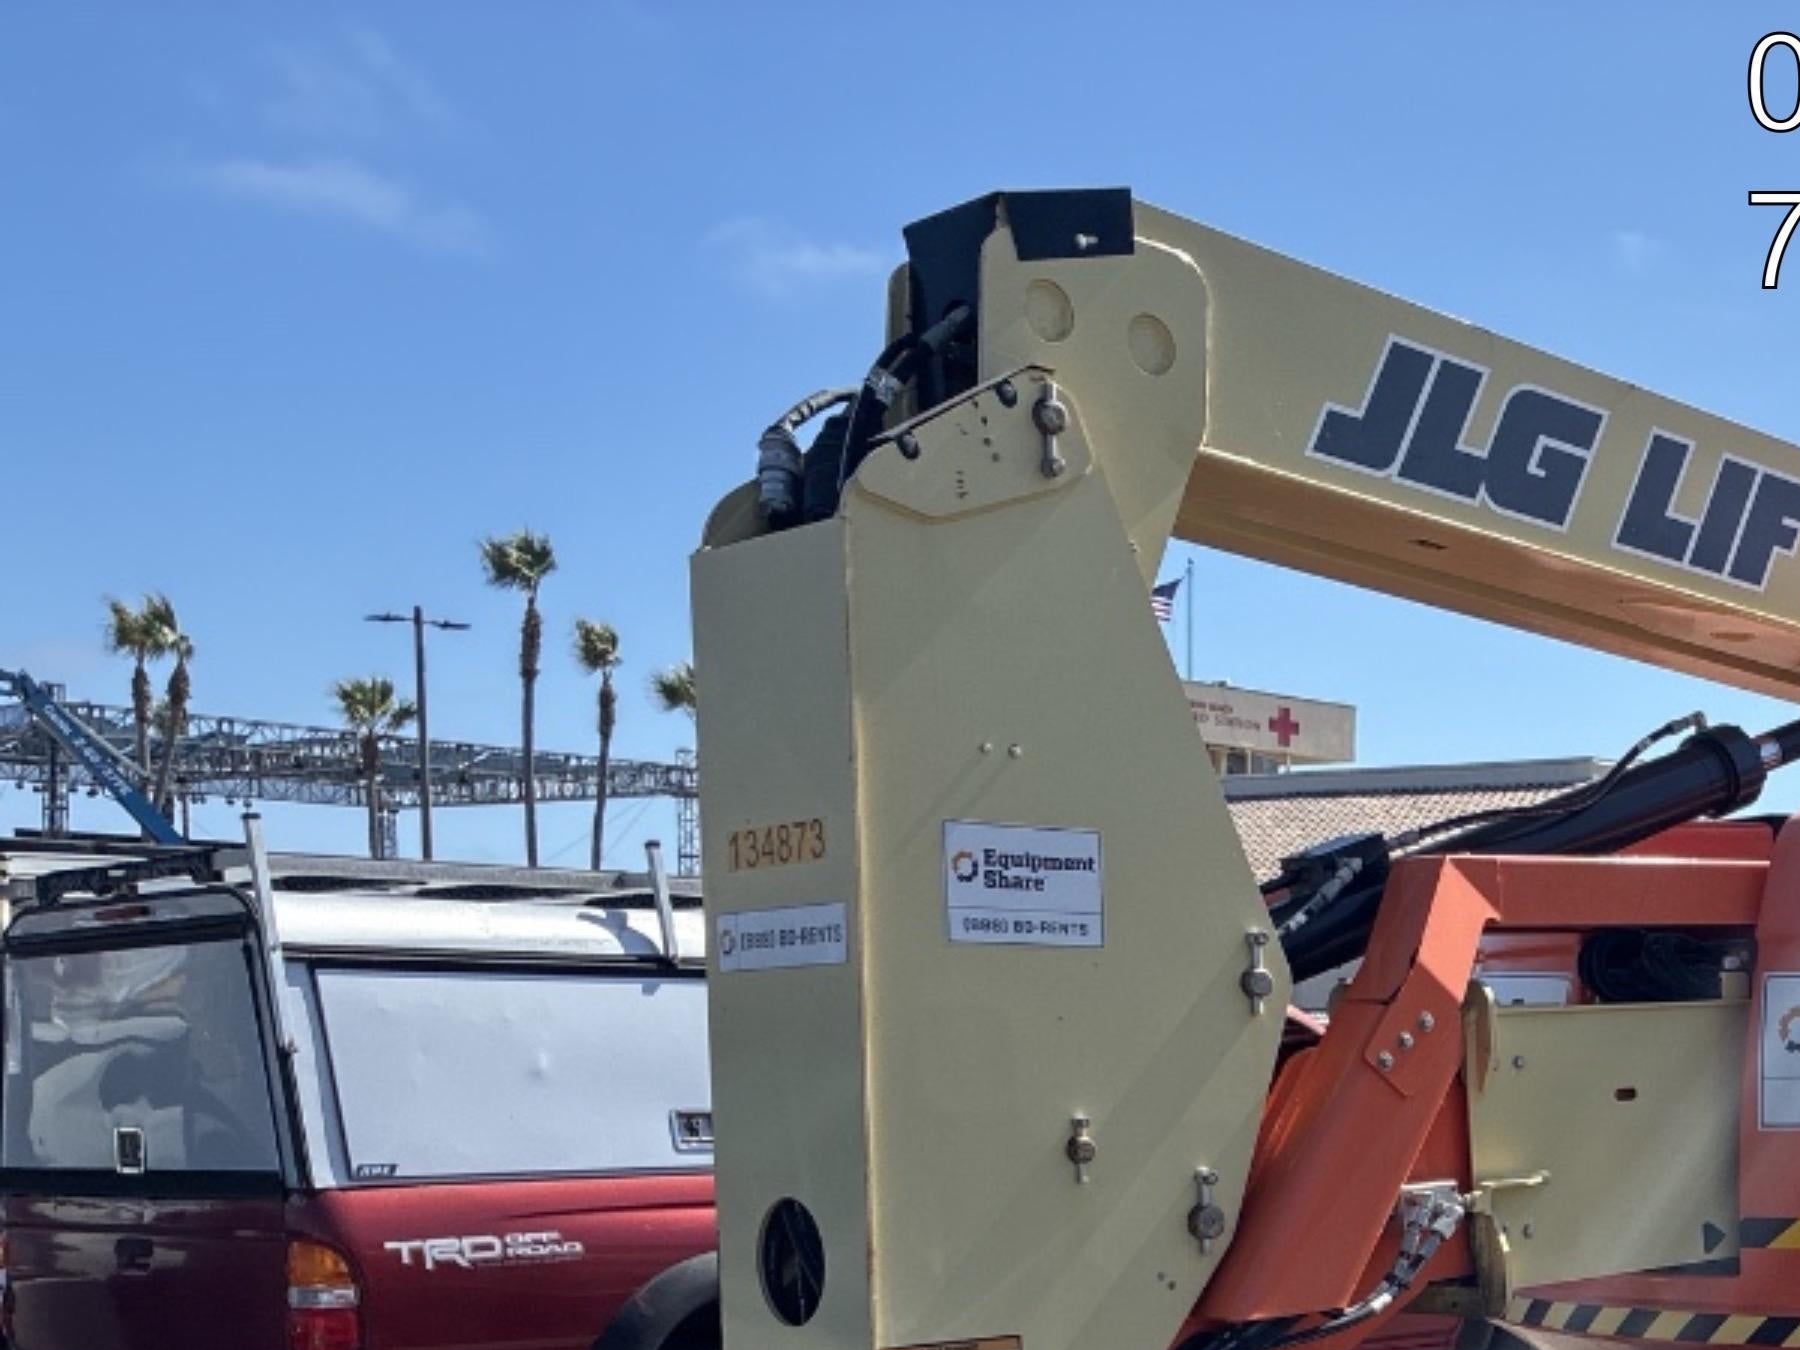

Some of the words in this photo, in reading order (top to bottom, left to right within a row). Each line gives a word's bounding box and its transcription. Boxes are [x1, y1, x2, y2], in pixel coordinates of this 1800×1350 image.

[1306, 332, 1611, 533] JLG
[728, 818, 826, 871] 134873
[983, 847, 1096, 873] Equipment
[983, 870, 1045, 892] Share
[383, 1235, 503, 1271] TRD
[506, 1231, 562, 1244] OFF
[507, 1241, 585, 1257] ROAD
